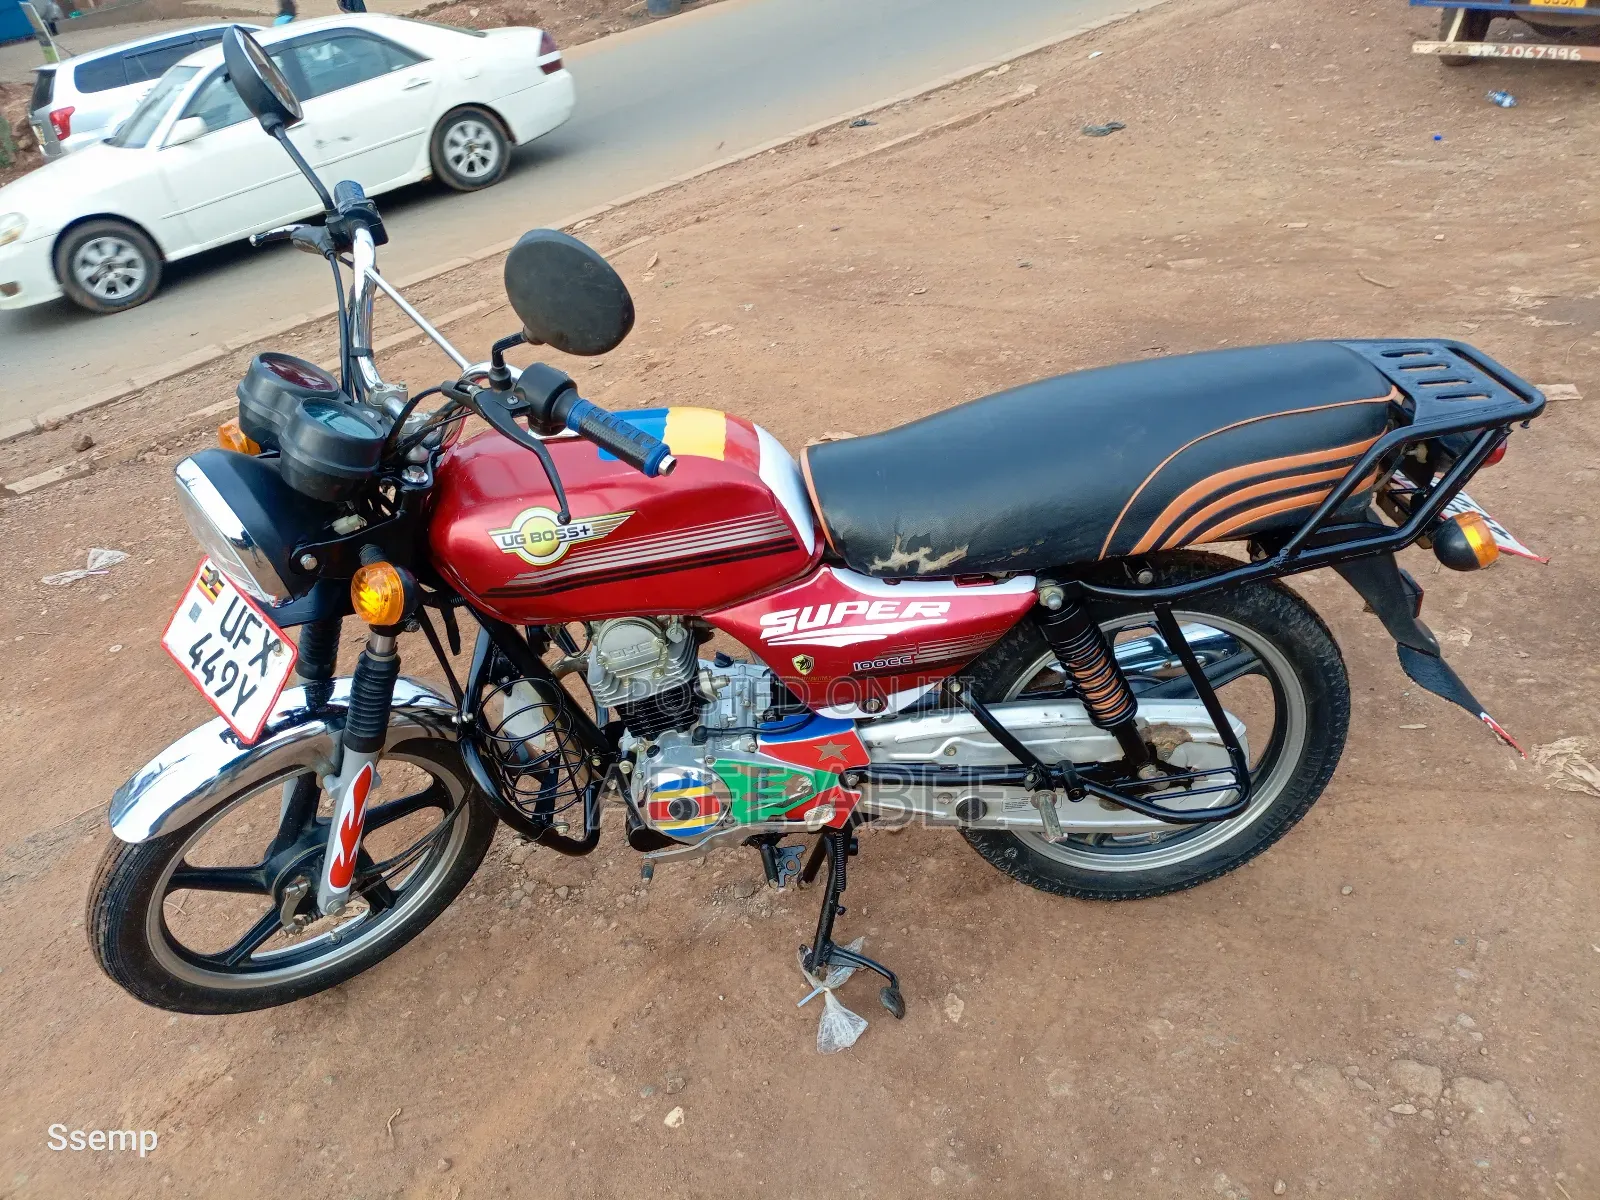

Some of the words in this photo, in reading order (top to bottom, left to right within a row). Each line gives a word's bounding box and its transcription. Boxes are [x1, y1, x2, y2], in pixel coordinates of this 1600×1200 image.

[501, 533, 527, 547] UG
[529, 525, 591, 544] BOSS+
[220, 595, 281, 677] UFX
[759, 600, 951, 640] SUPER
[188, 632, 259, 717] 449Y
[852, 655, 915, 672] 100CC
